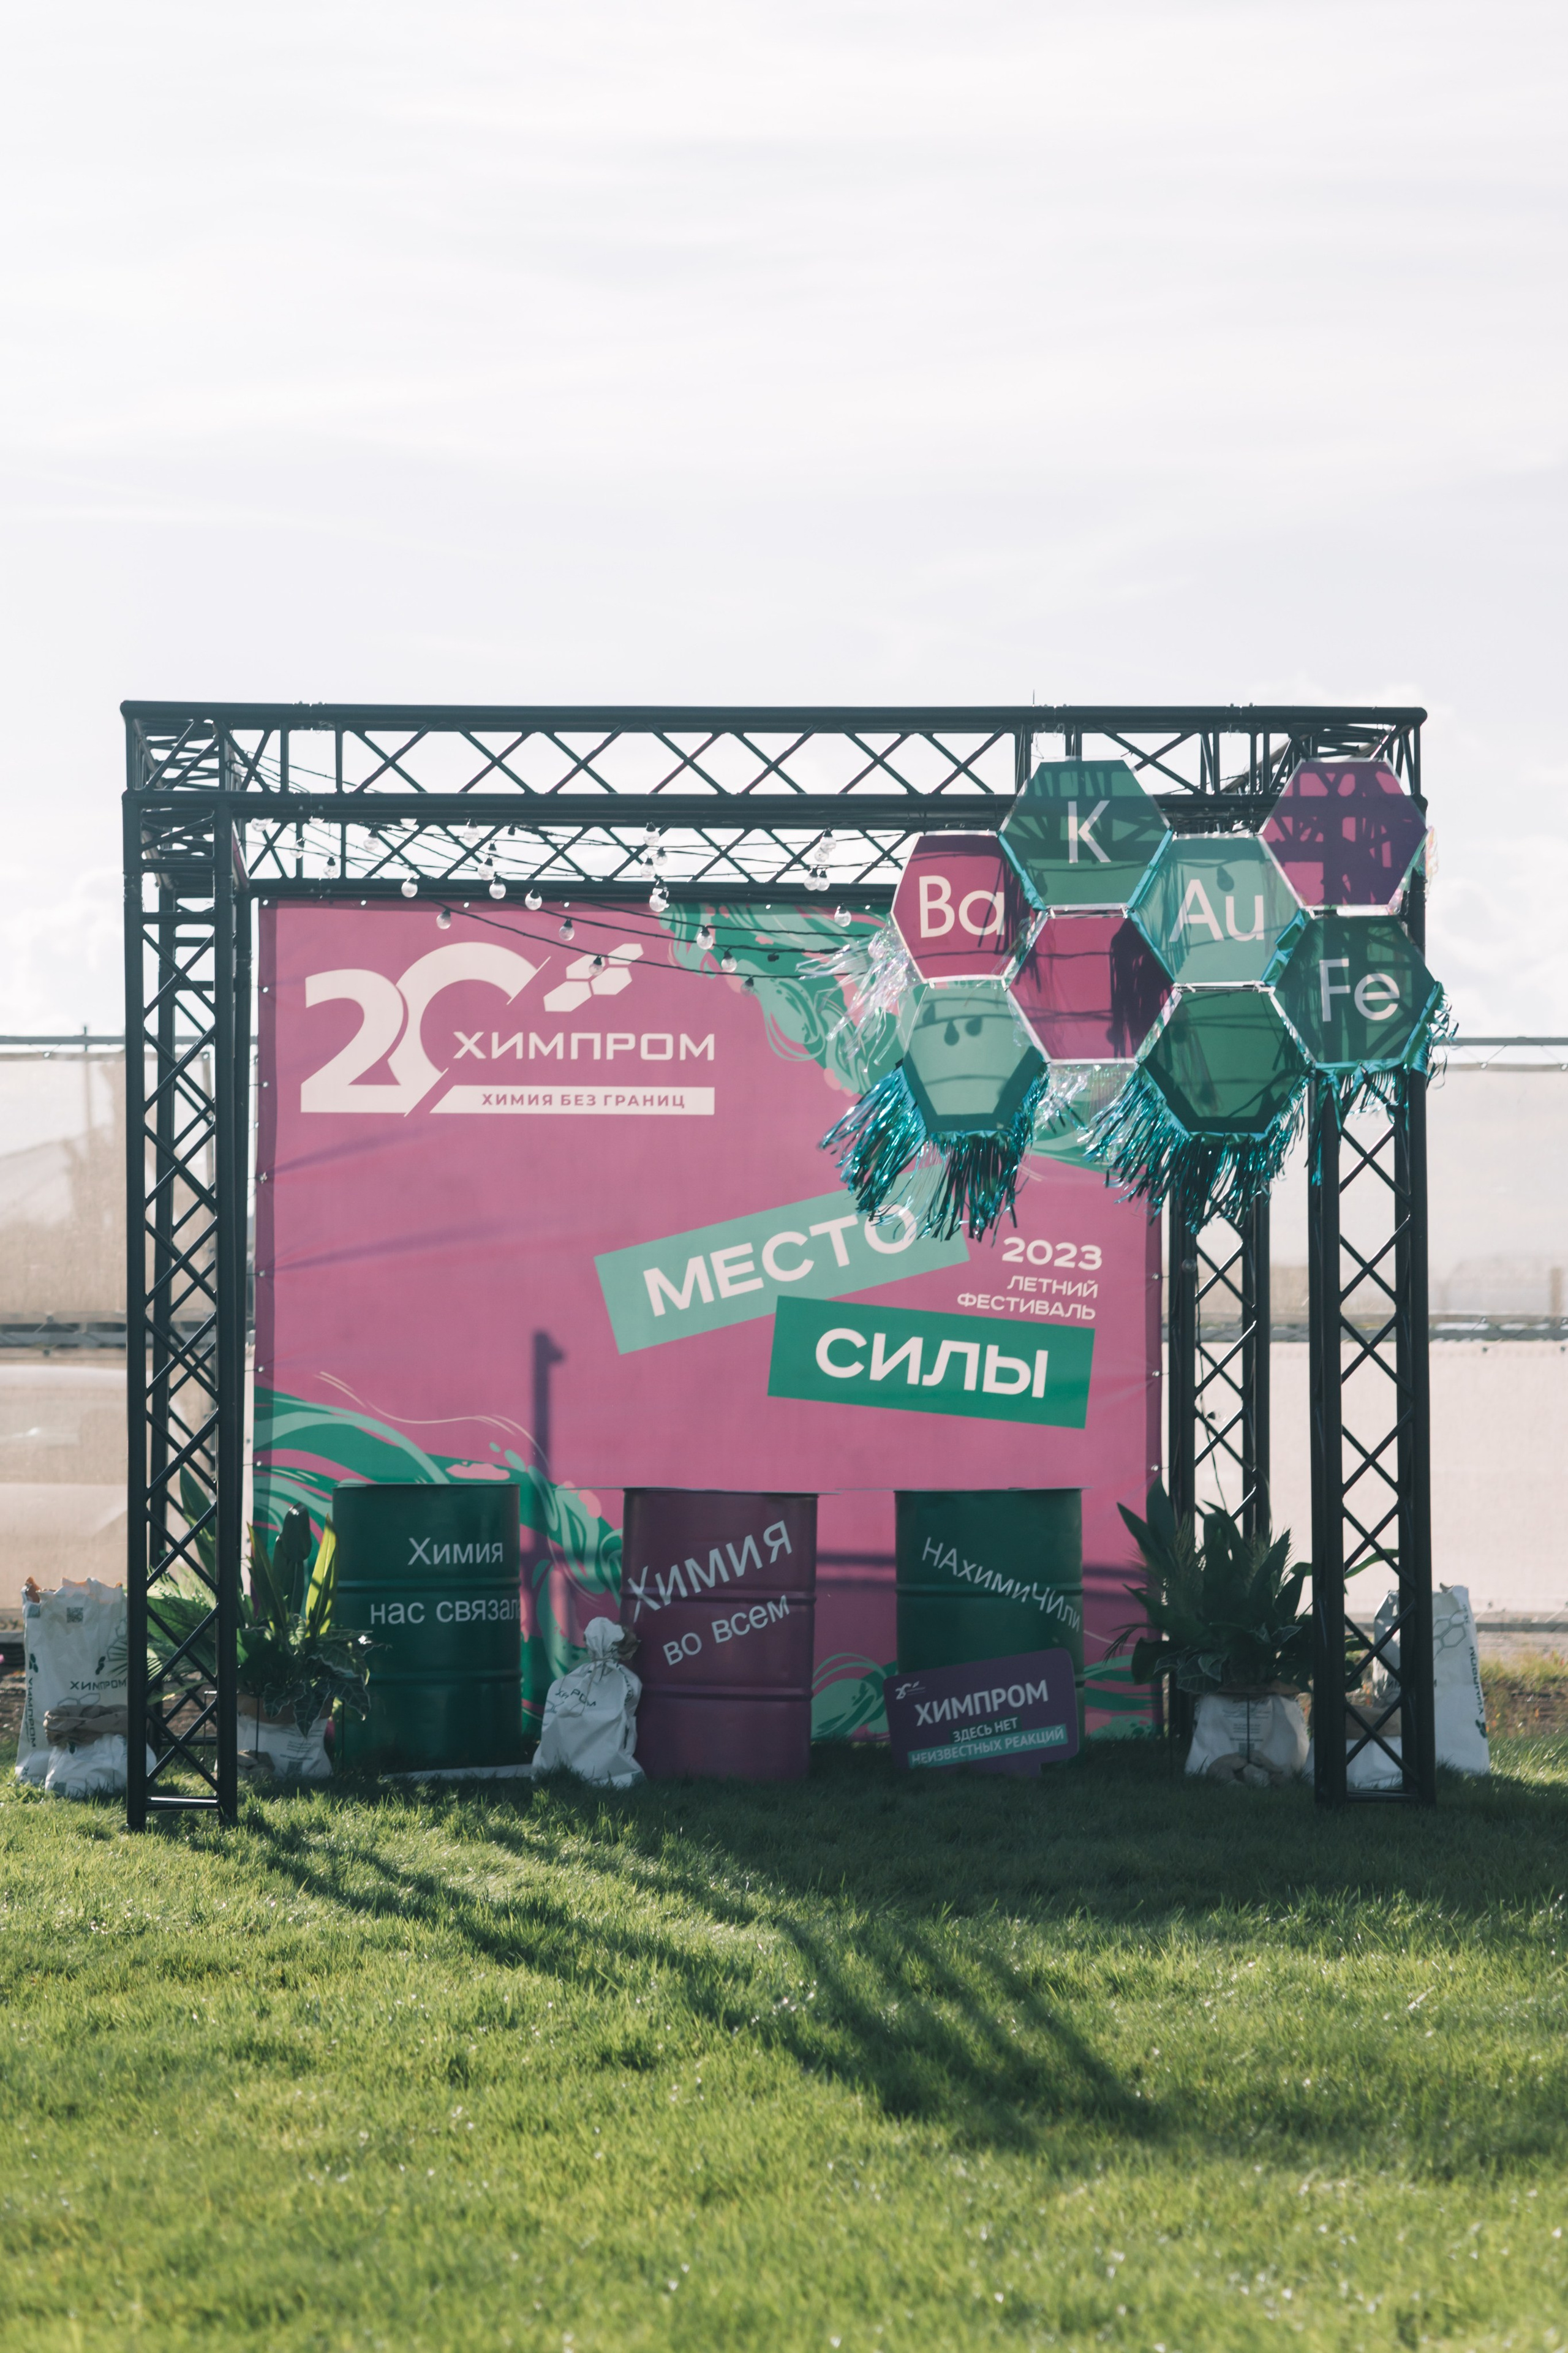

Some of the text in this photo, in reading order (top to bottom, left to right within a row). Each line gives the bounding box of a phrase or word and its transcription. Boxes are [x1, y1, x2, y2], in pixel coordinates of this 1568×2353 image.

[1068, 801, 1111, 864] K
[918, 875, 1005, 939] Ba
[1169, 879, 1265, 943] Au
[1319, 958, 1400, 1022] Fe
[453, 1031, 715, 1061] ХИМПРОМ
[482, 1093, 685, 1108] ХИМИЯ БЕЗ ГРАНИЦ
[643, 1204, 917, 1317] МЕСТО
[1002, 1236, 1102, 1271] 2023
[957, 1293, 1096, 1320] ФЕСТИВАЛЬ
[1006, 1275, 1098, 1299] ЛЕТНИЙ
[815, 1327, 1049, 1399] СИЛЫ
[371, 1602, 425, 1624] нас
[663, 1595, 790, 1666] во всем
[914, 1679, 1049, 1726] ХИМПРОМ
[911, 1726, 1065, 1766] НЕИЗВЕСТНЫХ РЕАКЦИЙ
[952, 1717, 1018, 1743] ЗДЕСЬ НЕТ
